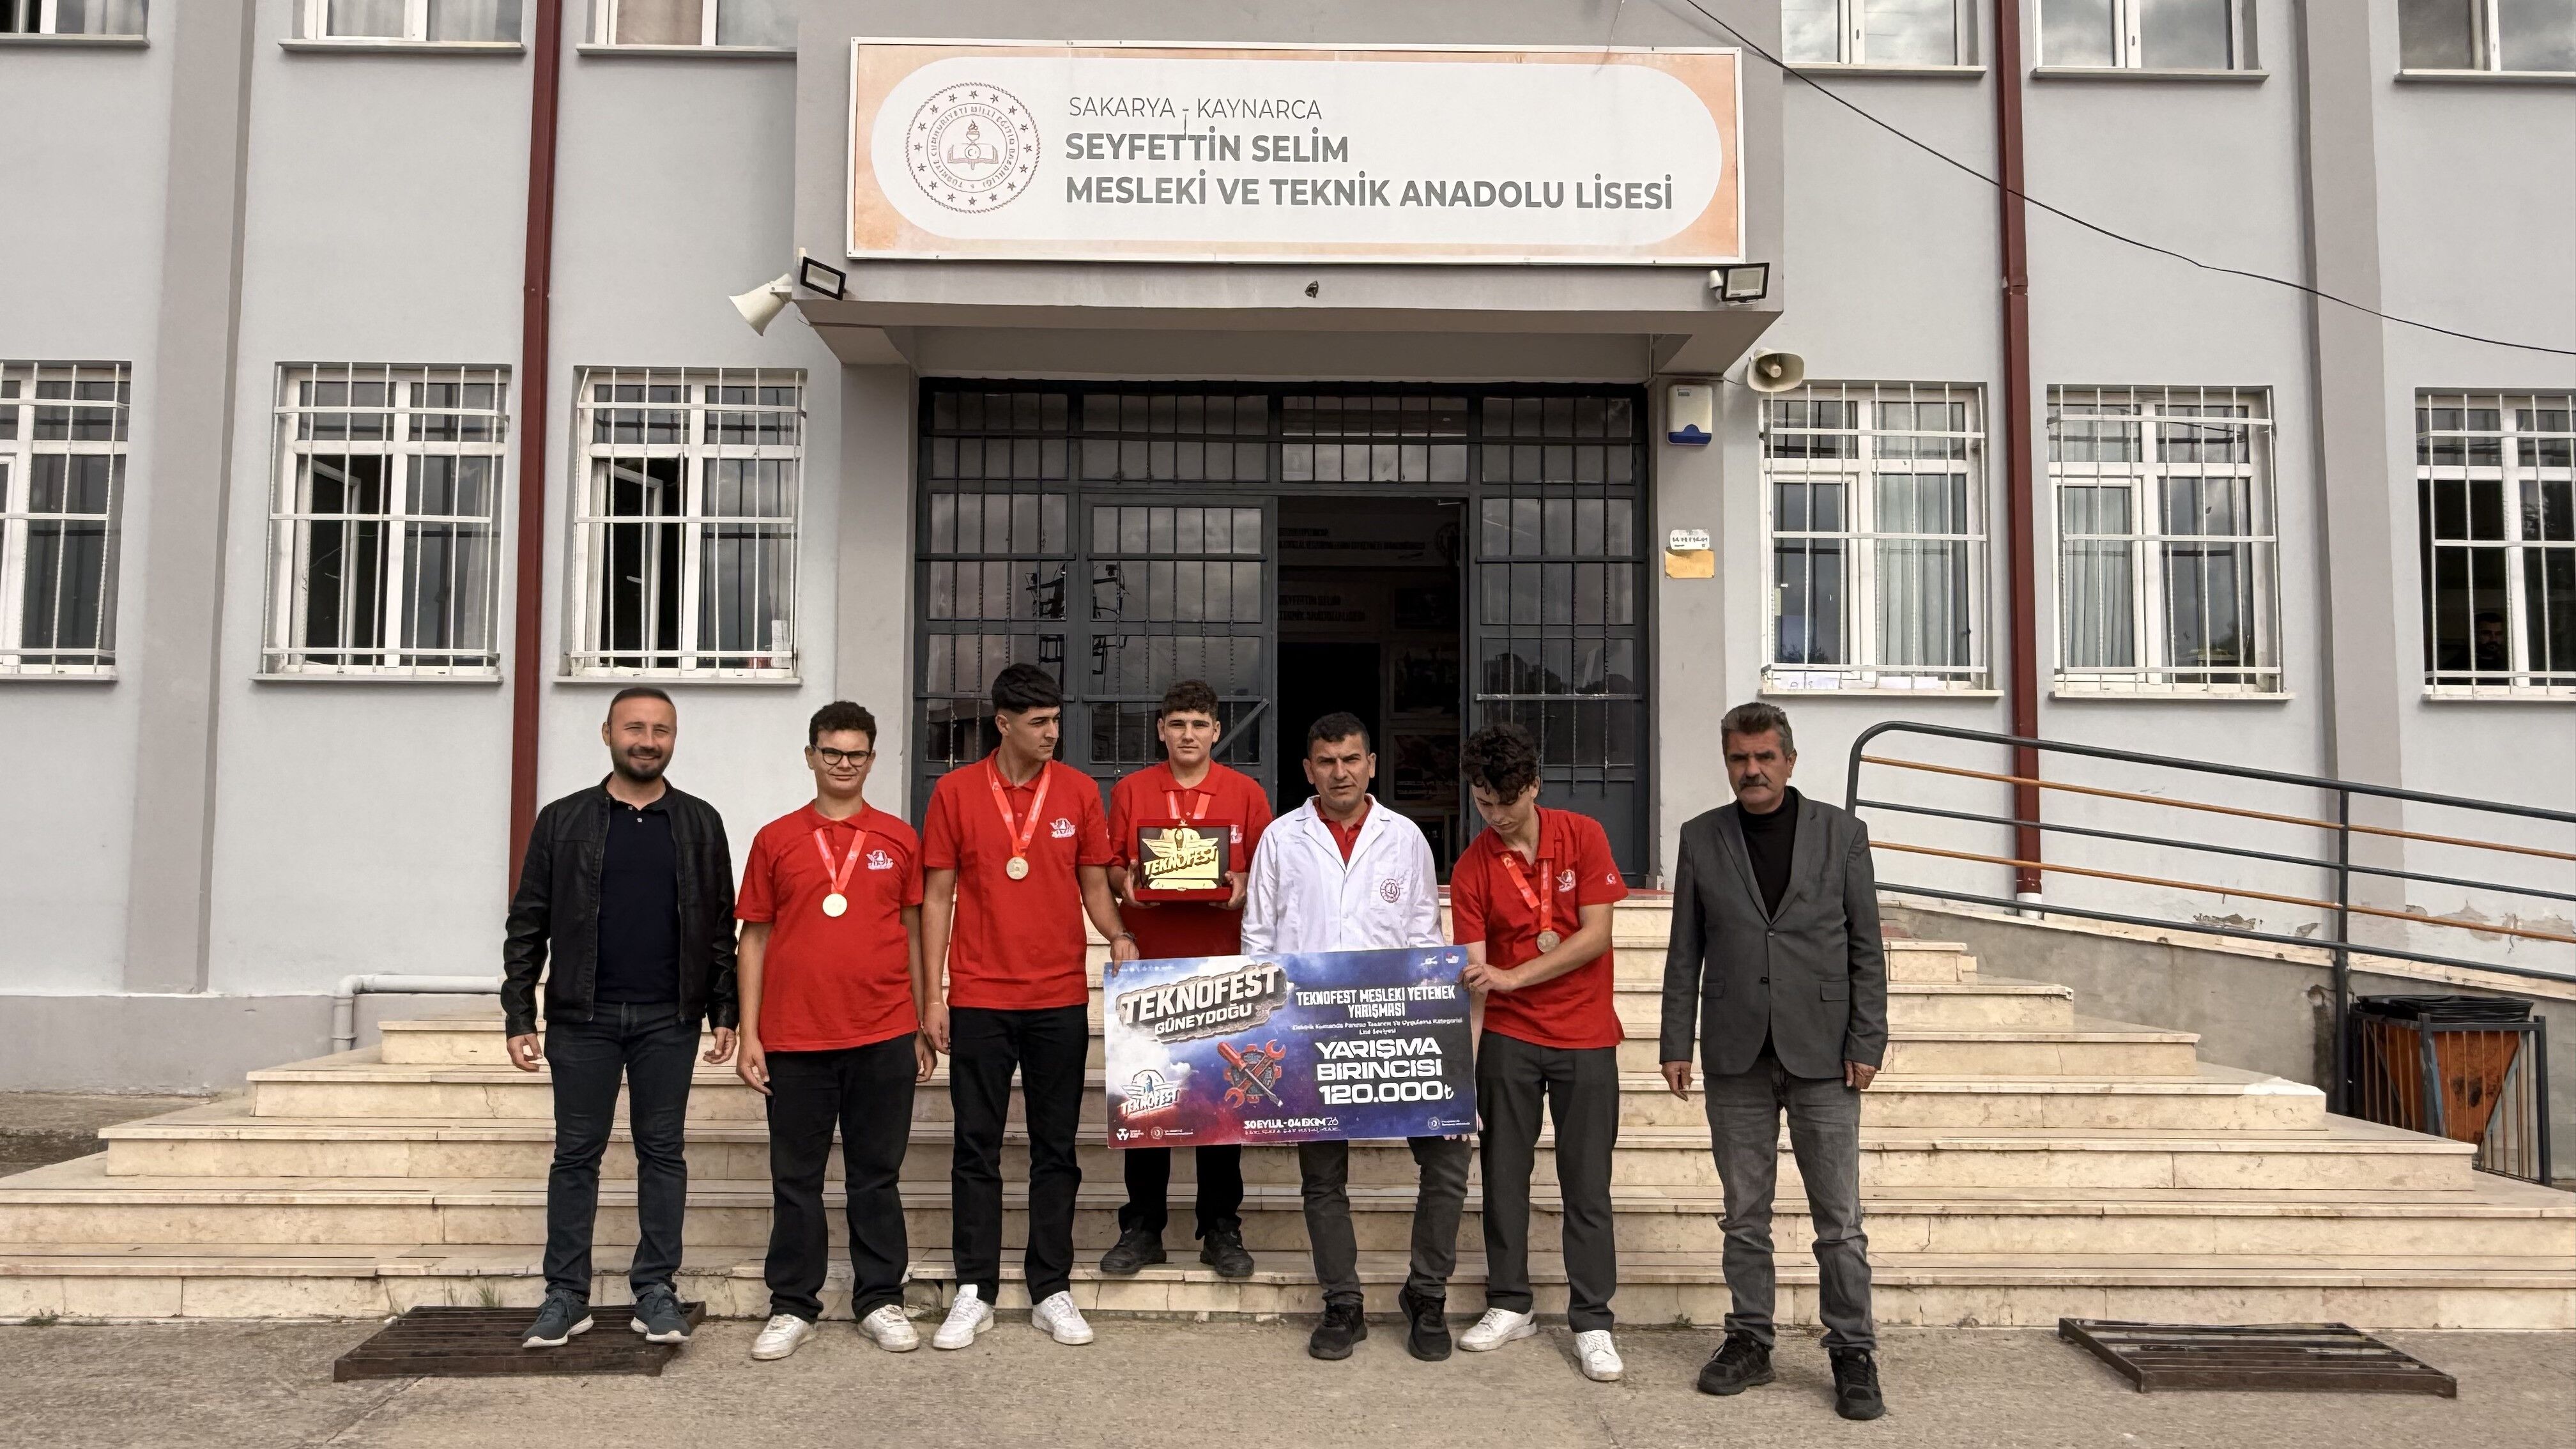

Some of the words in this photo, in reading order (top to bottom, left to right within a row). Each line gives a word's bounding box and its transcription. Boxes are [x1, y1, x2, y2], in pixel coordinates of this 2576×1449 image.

[1069, 96, 1176, 118] SAKARYA
[1197, 98, 1322, 119] KAYNARCA
[1065, 125, 1241, 161] SEYFETTİN
[1252, 126, 1348, 162] SELİM
[1066, 169, 1206, 204] MESLEKİ
[1216, 178, 1260, 205] VE
[1269, 171, 1391, 206] TEKNİK
[1399, 180, 1564, 209] ANADOLU
[1576, 173, 1672, 210] LİSESİ
[1143, 845, 1218, 875] TEKNOFEST
[1121, 966, 1280, 1025] TEKNOFEST
[1296, 990, 1357, 1006] TEKNOFEST
[1407, 985, 1455, 1002] YETENEK
[1348, 1002, 1406, 1018] YARIŞMASI
[1154, 1002, 1252, 1035] GÜNEYDOĞU
[1315, 1037, 1443, 1059] YARIŞMA
